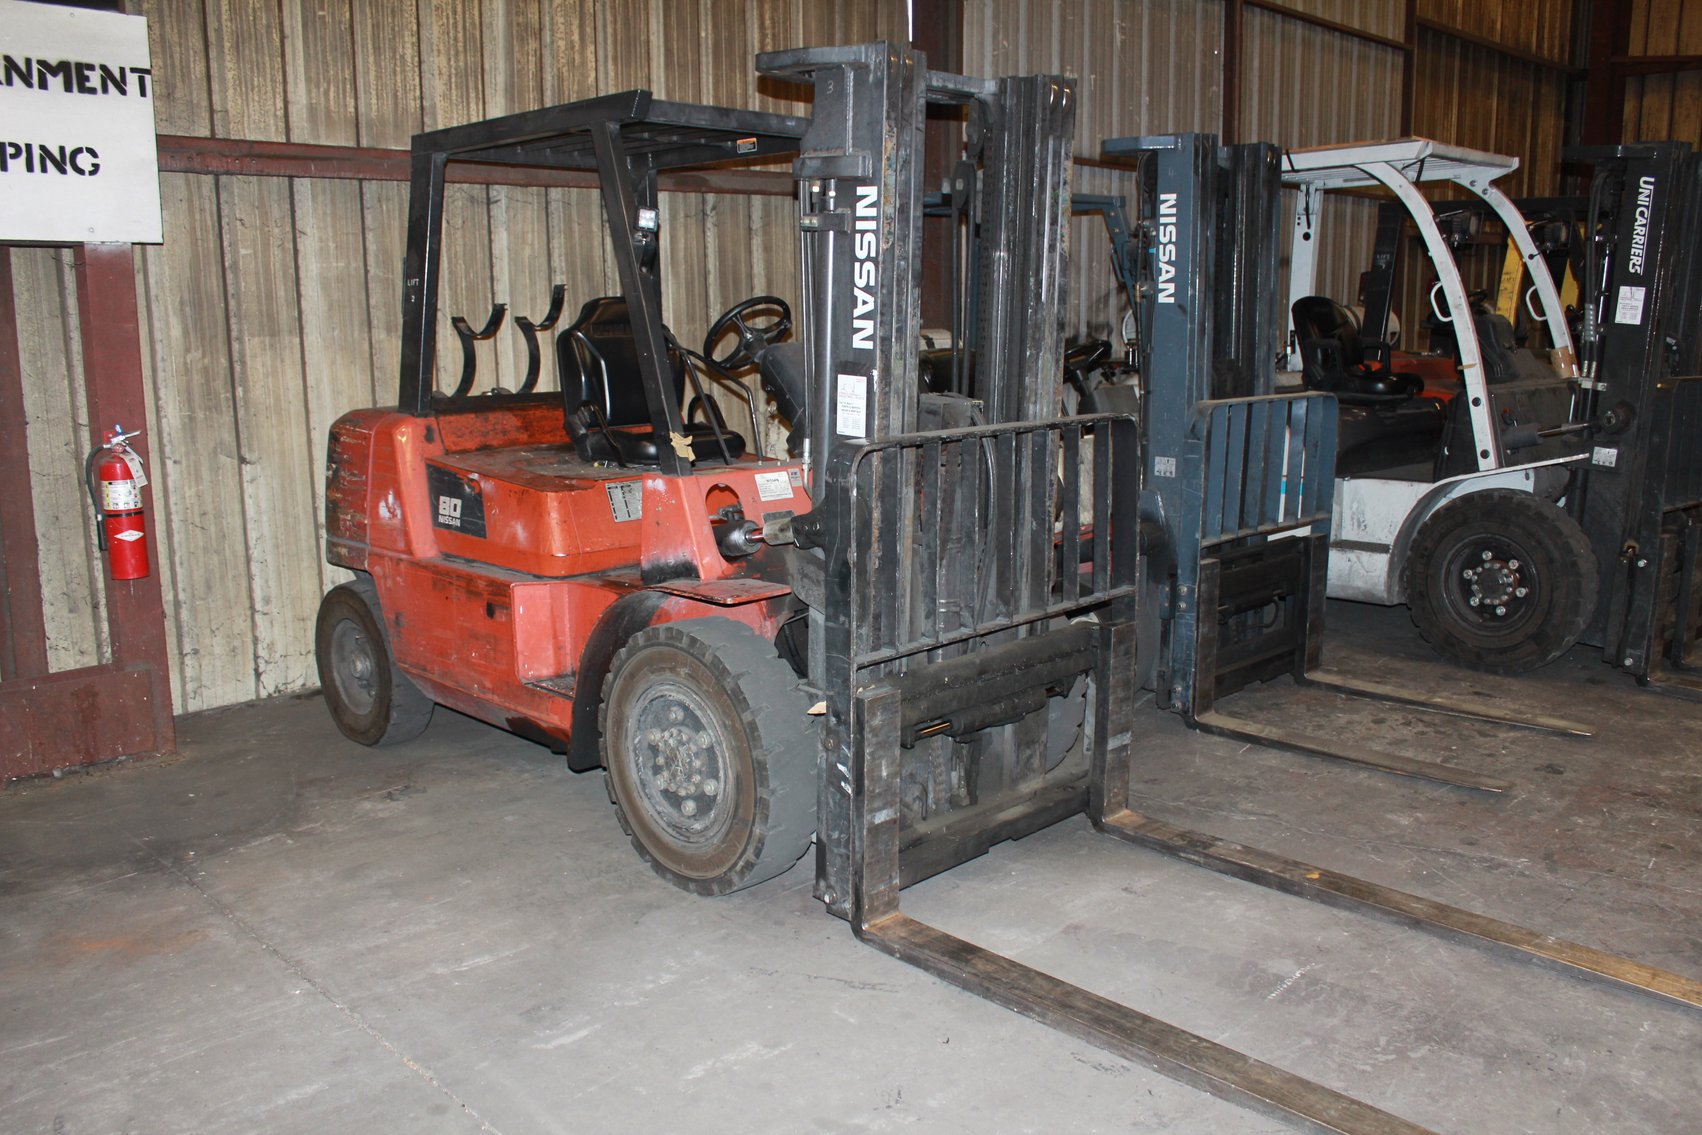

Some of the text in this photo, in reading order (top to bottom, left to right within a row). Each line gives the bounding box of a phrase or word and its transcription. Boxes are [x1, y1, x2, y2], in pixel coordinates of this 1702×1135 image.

[0, 54, 152, 98] NMENT
[1628, 176, 1655, 276] UNICARRIERS
[852, 185, 878, 350] NISSAN
[1158, 193, 1177, 304] NISSAN
[408, 278, 419, 286] LIFT
[438, 515, 461, 527] NISSAN
[439, 495, 462, 518] 80
